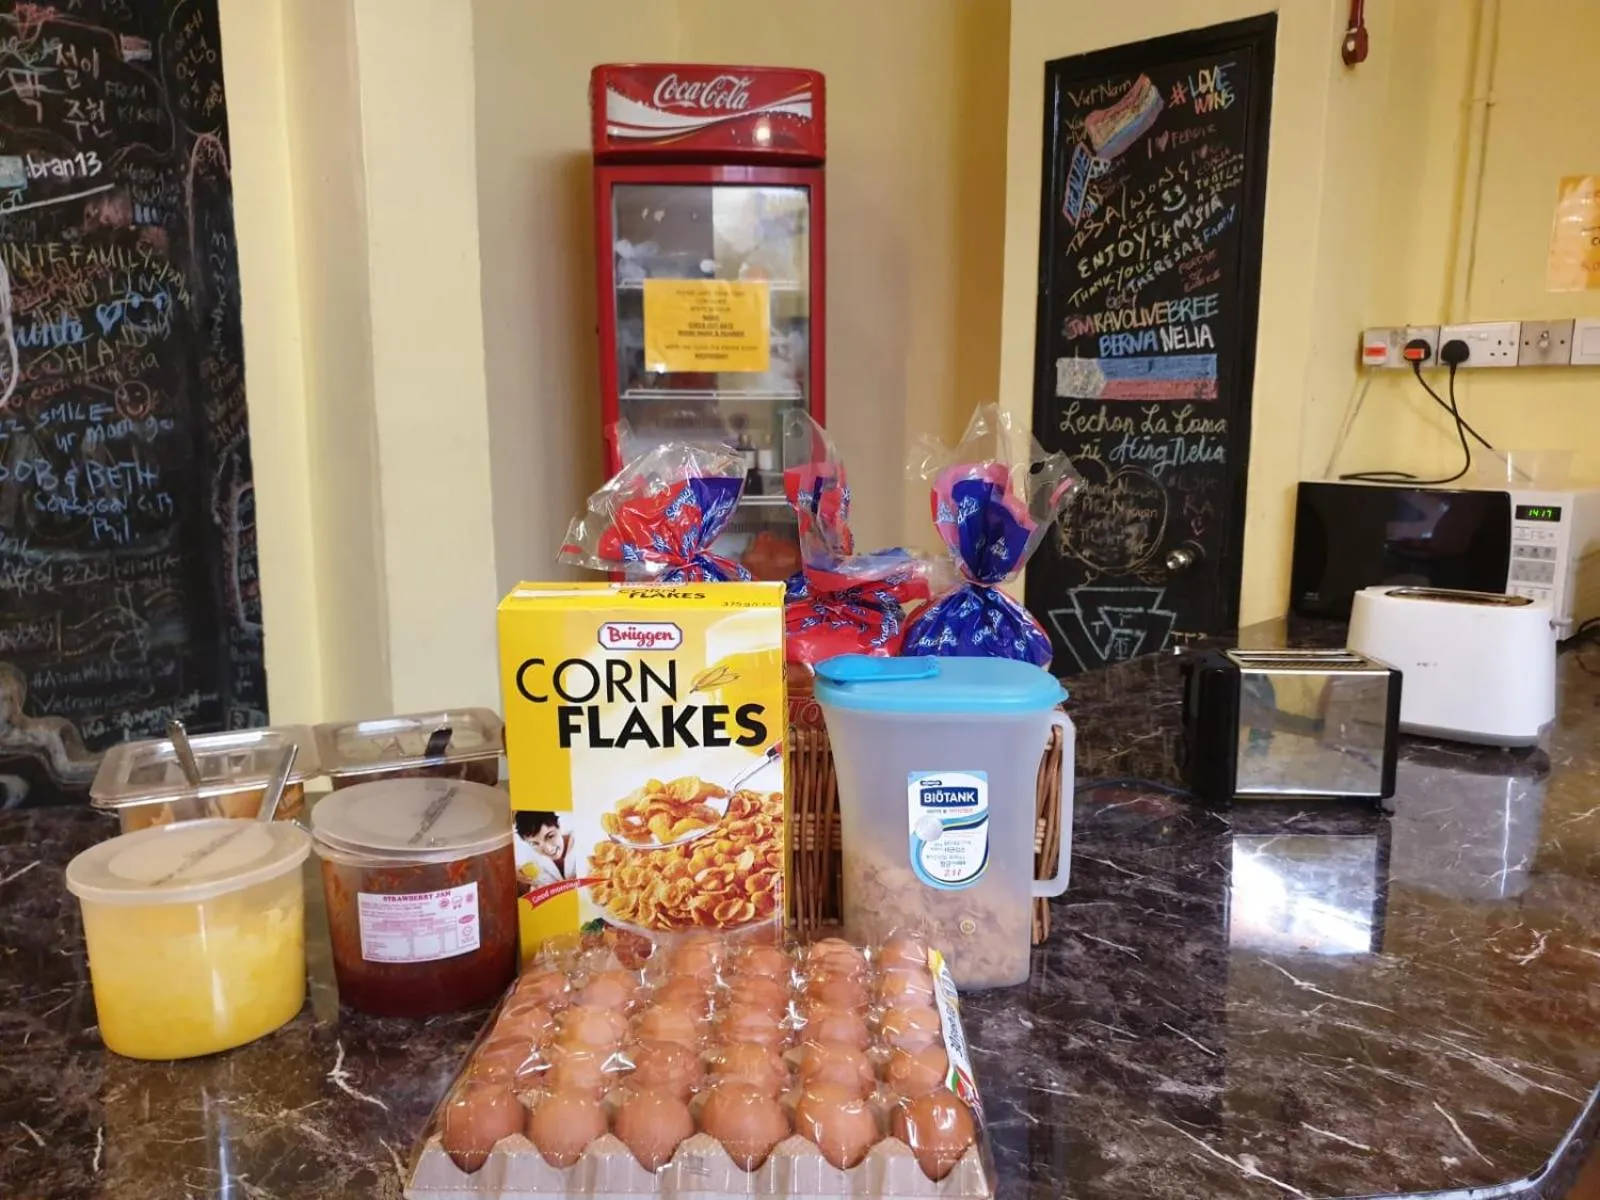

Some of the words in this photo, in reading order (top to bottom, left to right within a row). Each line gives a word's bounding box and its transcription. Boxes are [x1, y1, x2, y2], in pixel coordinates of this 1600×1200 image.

[1160, 323, 1215, 352] NELIA
[606, 625, 676, 647] Brüggen
[516, 658, 678, 704] CORN
[557, 703, 768, 749] FLAKES
[435, 890, 451, 898] JAM
